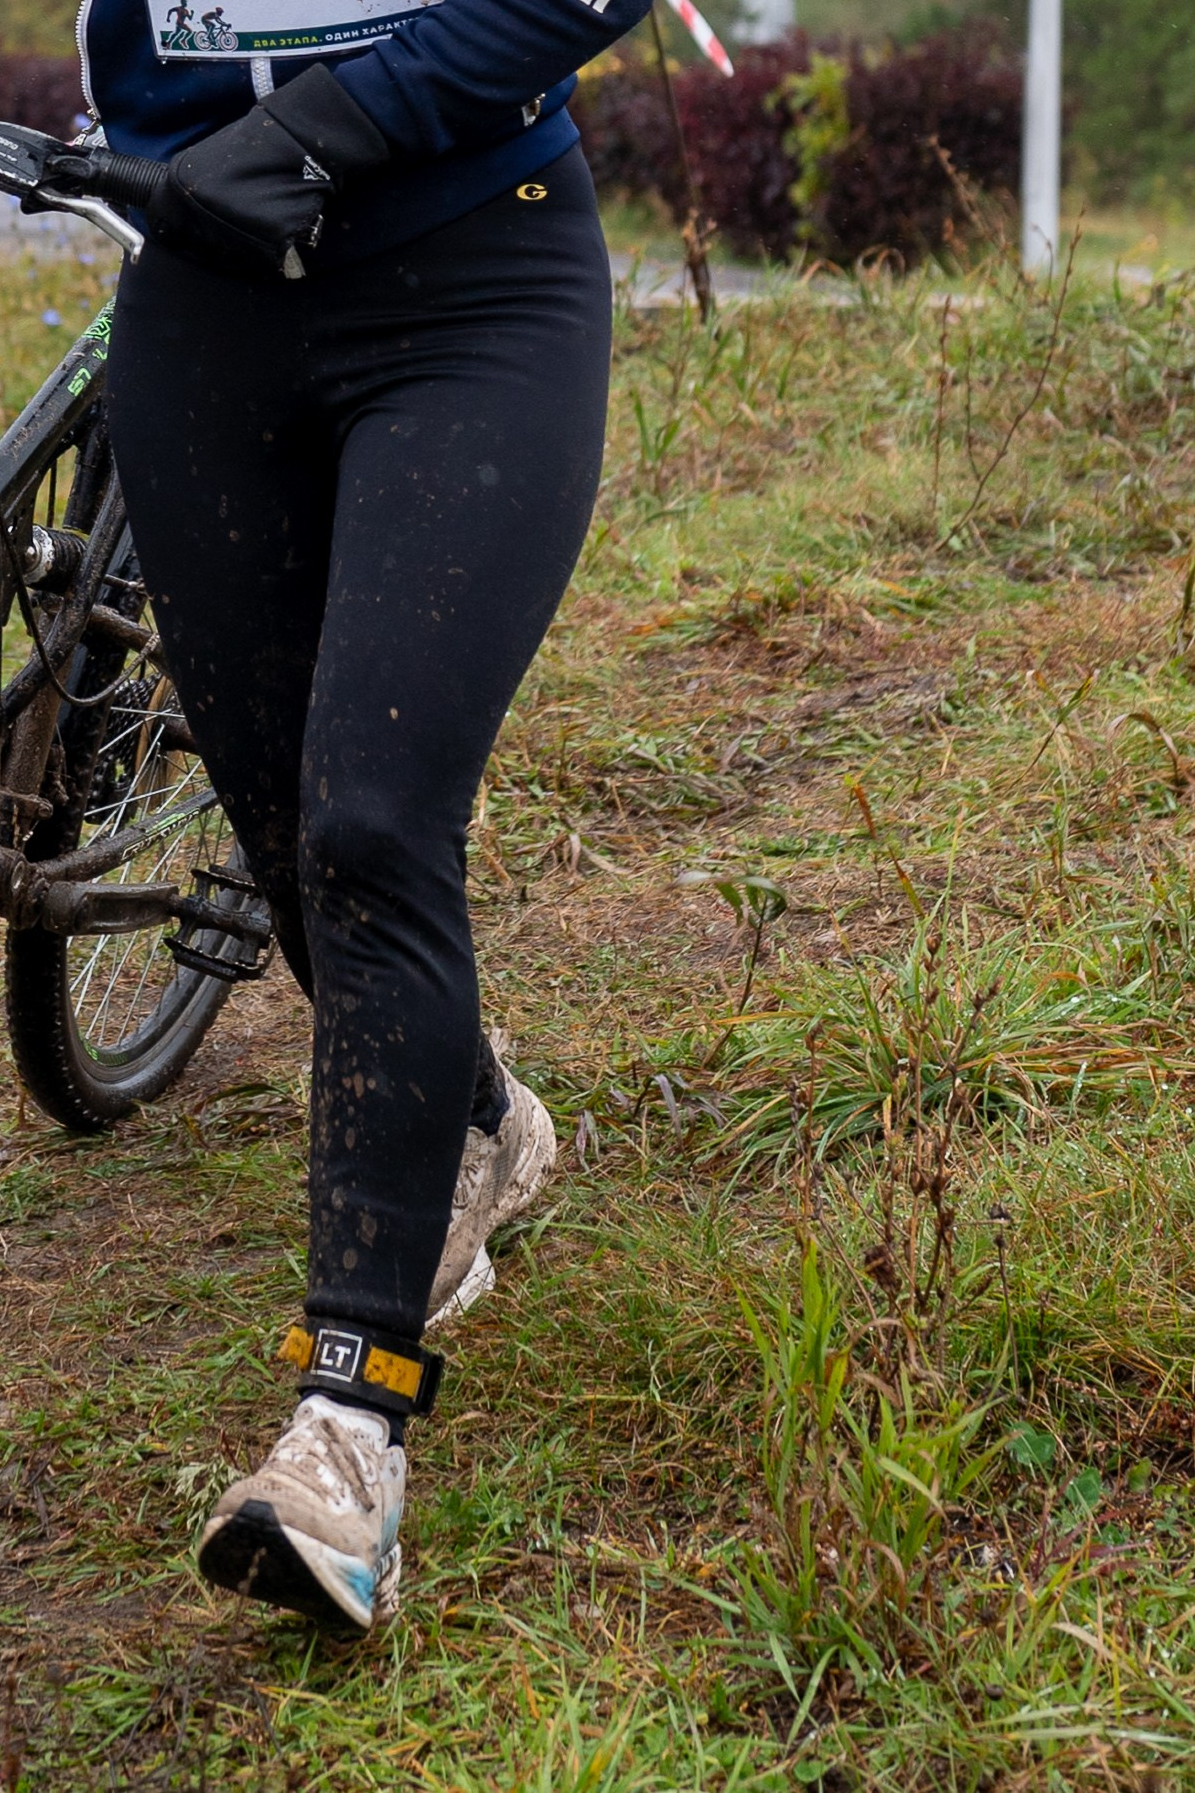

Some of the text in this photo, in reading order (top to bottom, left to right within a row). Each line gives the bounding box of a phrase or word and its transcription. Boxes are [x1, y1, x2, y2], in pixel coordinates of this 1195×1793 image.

[253, 39, 276, 48] ДВА
[325, 29, 359, 42] ОДИН
[362, 17, 419, 36] ХАРАКТ
[517, 184, 547, 200] G
[320, 1343, 351, 1368] LT
